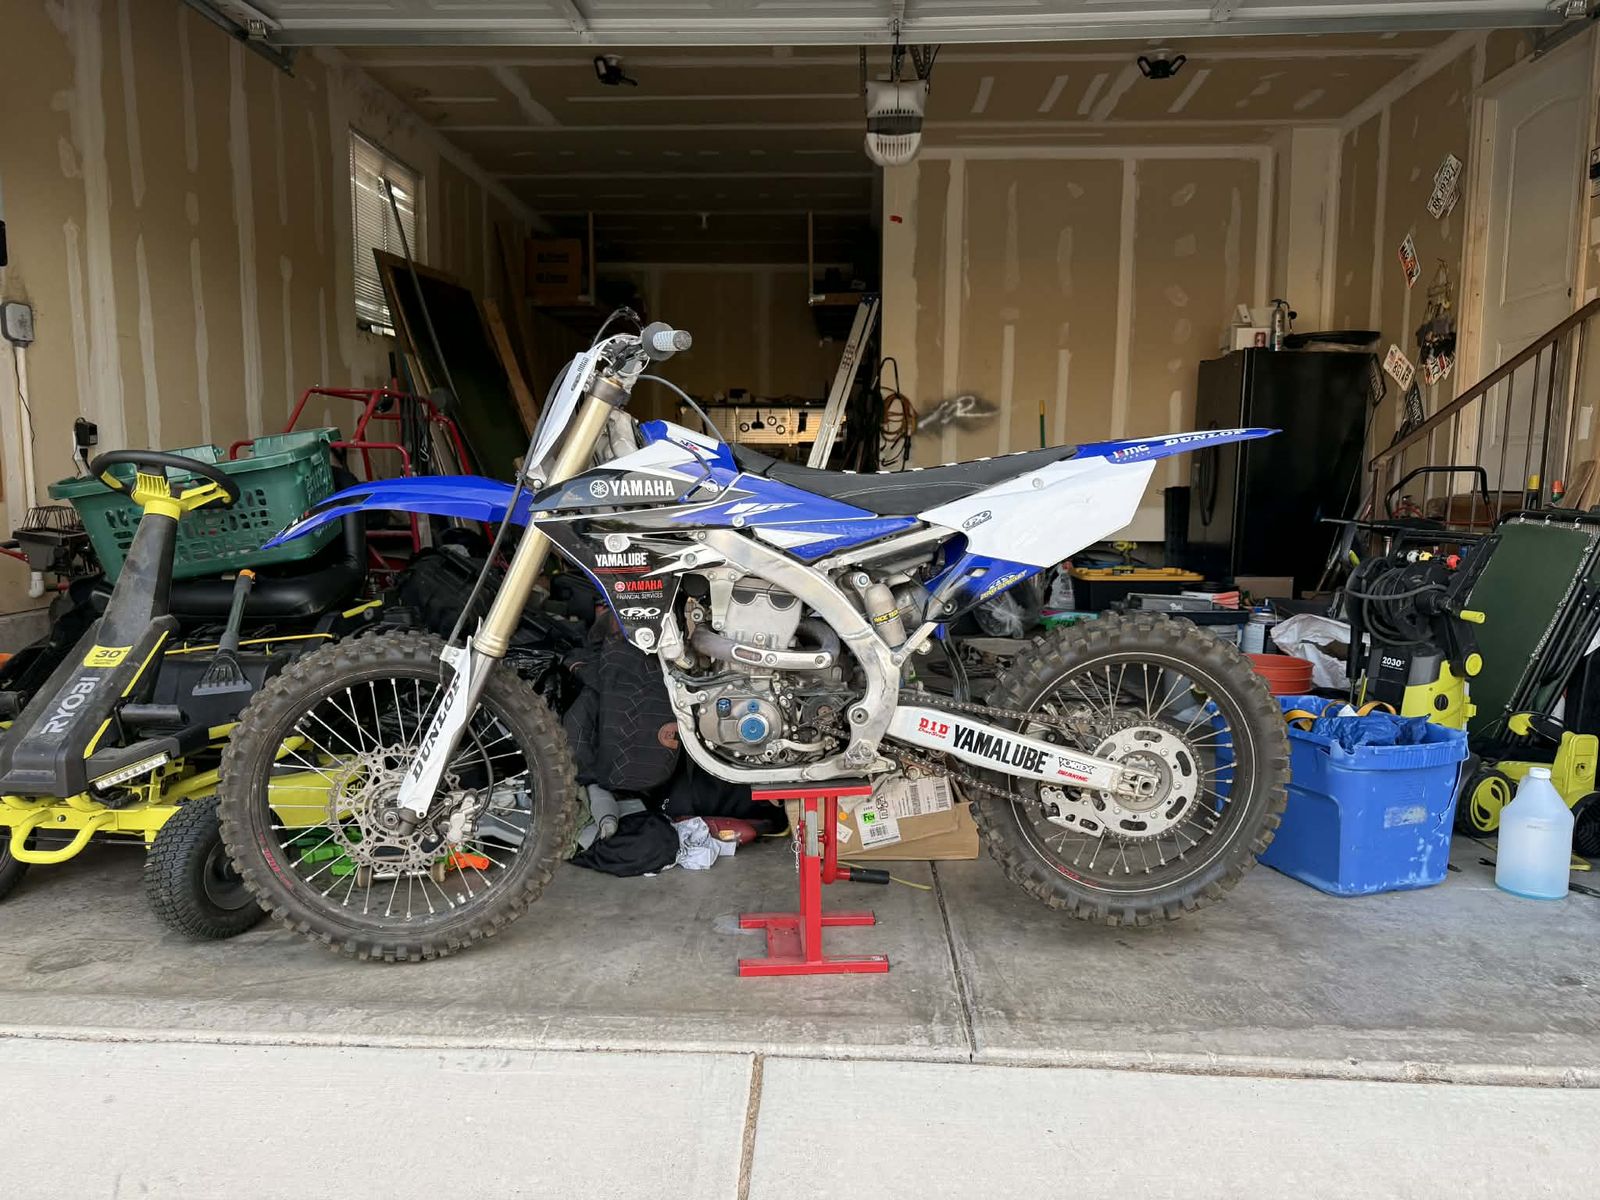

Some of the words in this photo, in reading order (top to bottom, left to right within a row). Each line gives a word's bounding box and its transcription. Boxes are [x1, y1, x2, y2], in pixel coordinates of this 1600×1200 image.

[1164, 429, 1247, 447] DUNLOP
[608, 480, 675, 496] YAMAHA
[594, 552, 649, 567] YAMALUBE
[625, 579, 663, 591] YAMAHA
[1382, 656, 1402, 667] 2030
[40, 676, 100, 735] RYOBI
[412, 672, 461, 783] DUNLOP
[952, 724, 1049, 774] YAMALUBE
